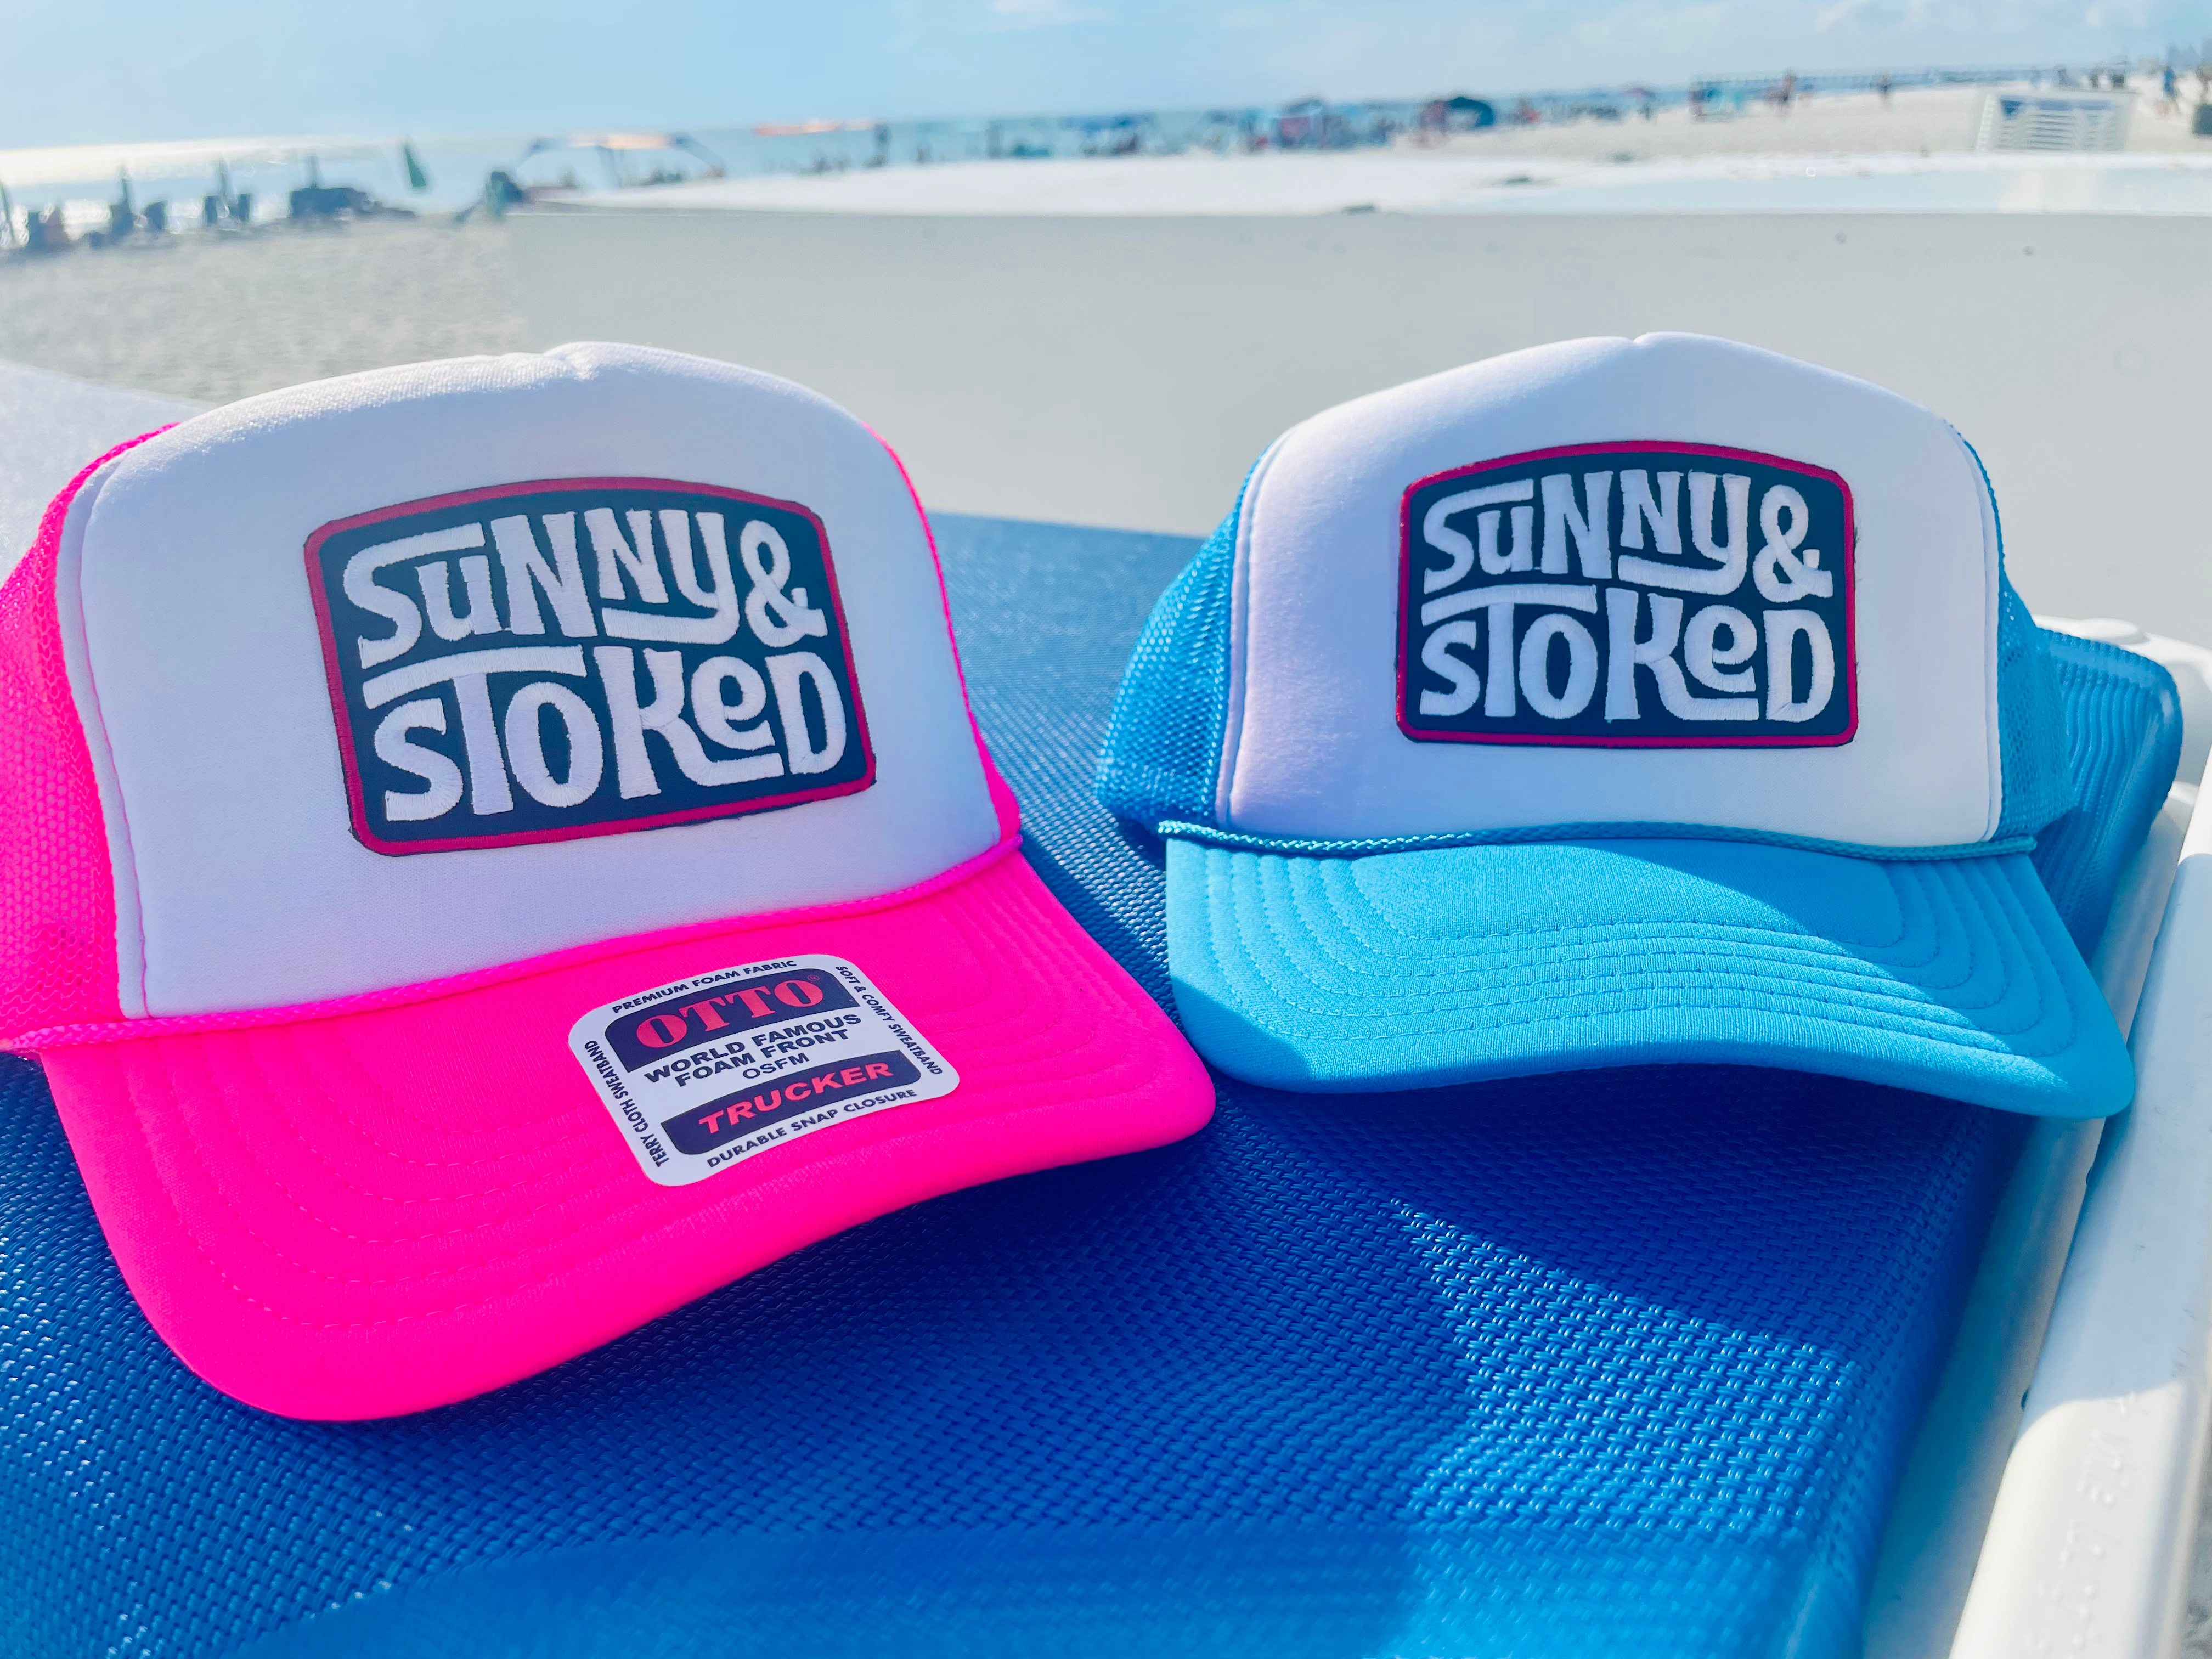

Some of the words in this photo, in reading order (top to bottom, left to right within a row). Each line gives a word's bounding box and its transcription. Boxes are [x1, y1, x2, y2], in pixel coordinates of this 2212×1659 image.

[1752, 484, 1833, 603] &
[740, 520, 828, 648] &
[612, 983, 689, 1014] PREMIUM
[692, 970, 741, 987] FOAM
[743, 960, 797, 974] FABRIC
[636, 979, 823, 1048] OTTO
[836, 966, 861, 984] SOFT
[862, 994, 896, 1022] COMFY
[888, 1024, 943, 1075] SWEATBAND
[584, 1040, 629, 1099] SWEATBAND
[644, 1041, 746, 1083] WORLD
[751, 1014, 862, 1047] FAMOUS
[675, 1052, 756, 1087] FOAM
[760, 1029, 848, 1059] FRONT
[742, 1052, 810, 1079] OSFM
[619, 1098, 649, 1132] CLOTH
[698, 1062, 894, 1134] TRUCKER
[707, 1127, 788, 1168] DURABLE
[790, 1108, 838, 1131] SNAP
[843, 1089, 917, 1113] CLOSURE
[640, 1133, 670, 1167] TERRY
